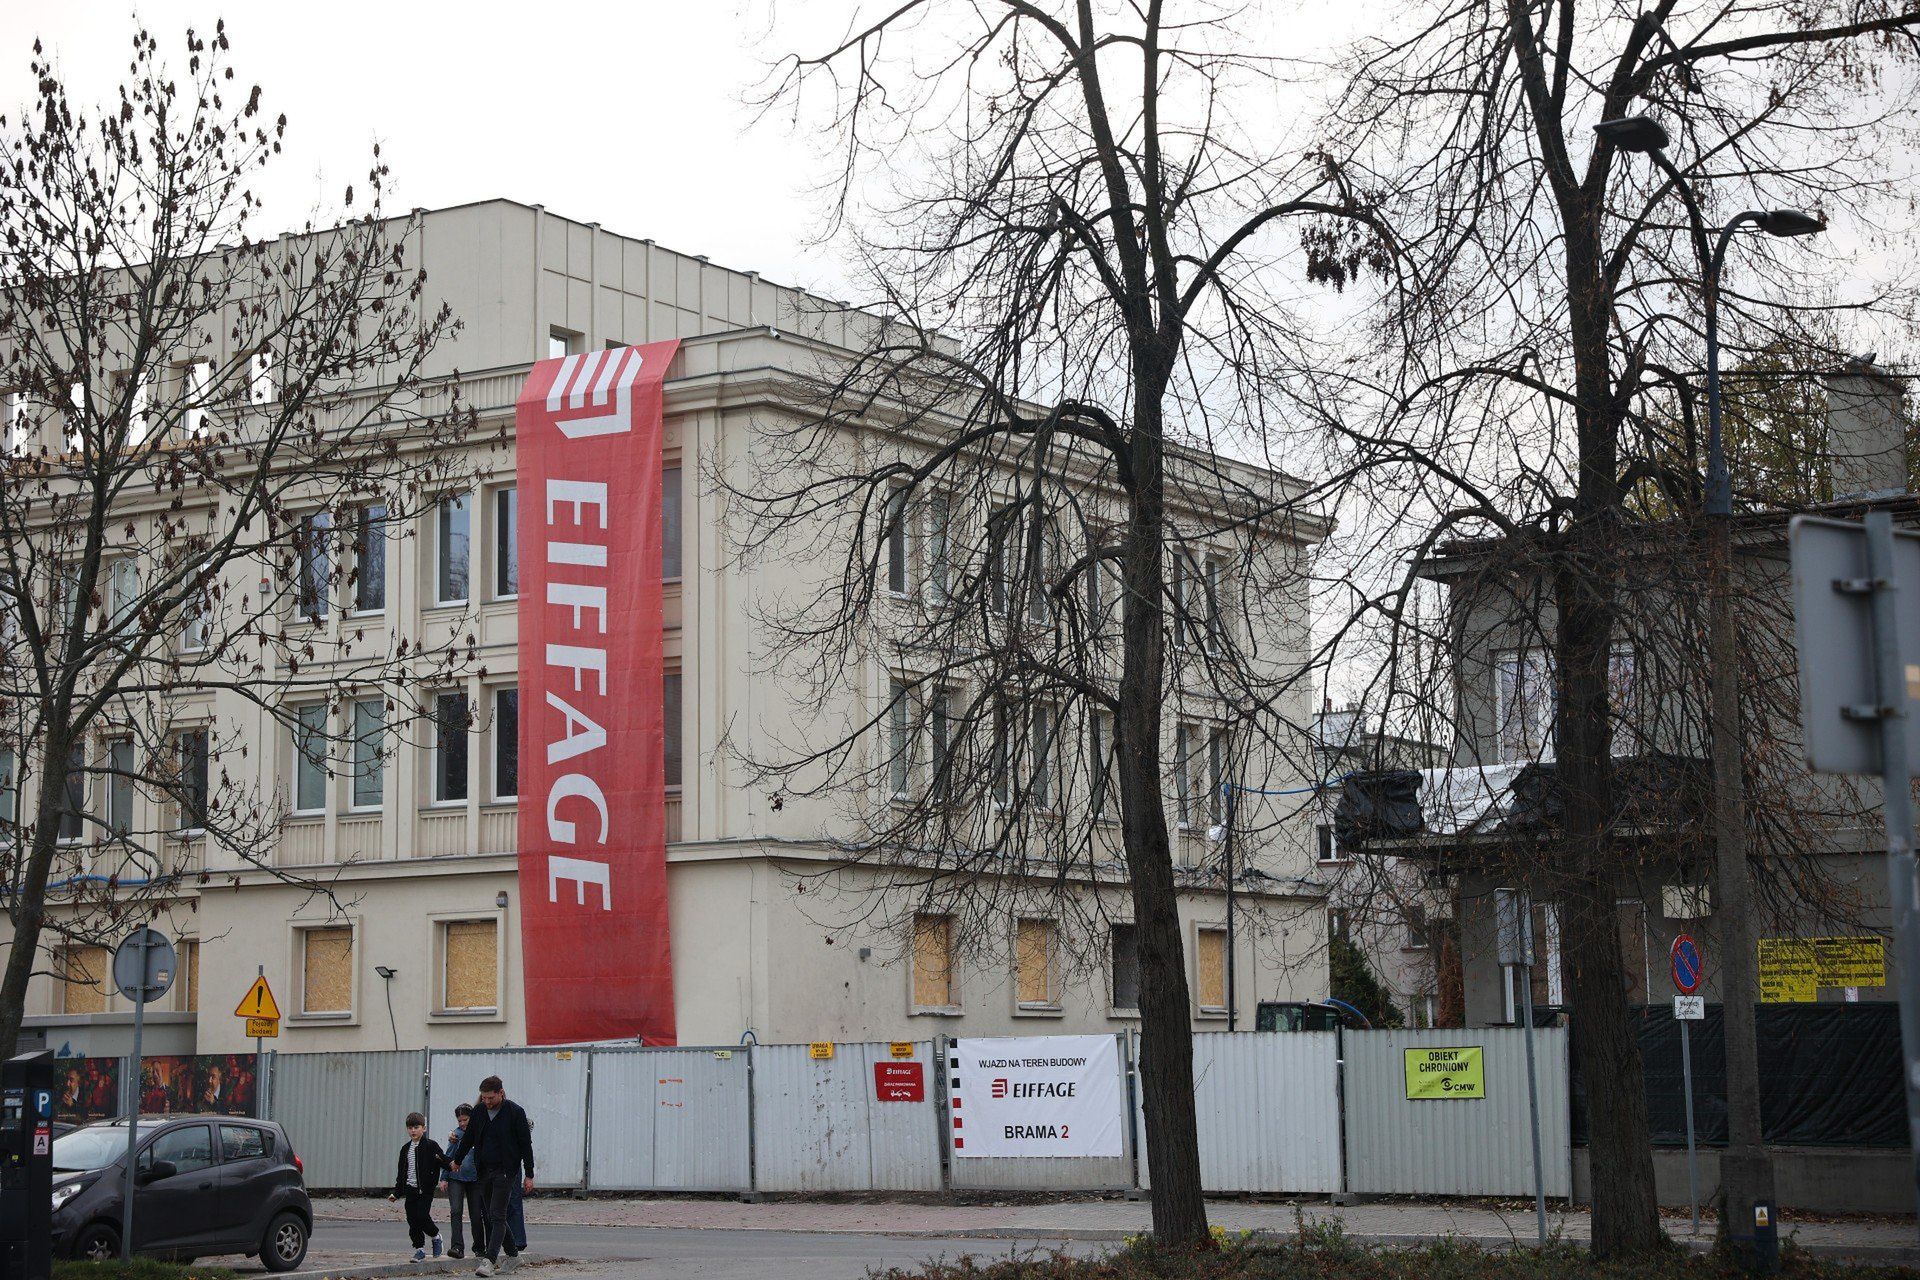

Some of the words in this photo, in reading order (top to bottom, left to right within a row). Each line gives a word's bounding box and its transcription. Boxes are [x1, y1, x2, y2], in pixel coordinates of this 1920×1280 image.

[545, 478, 611, 911] EIFFAGE
[1428, 1051, 1459, 1061] OBIEKT
[978, 1059, 1007, 1068] WJAZD
[1008, 1059, 1021, 1068] NA
[1021, 1058, 1049, 1068] TEREN
[1050, 1057, 1087, 1067] BUDOWY
[1419, 1062, 1469, 1073] CHRONIONY
[1013, 1082, 1076, 1098] EIFFAGE
[1454, 1083, 1475, 1091] CMW
[38, 1092, 50, 1113] P
[1004, 1125, 1058, 1139] BRAMA
[1061, 1124, 1069, 1139] 2
[37, 1137, 45, 1147] A
